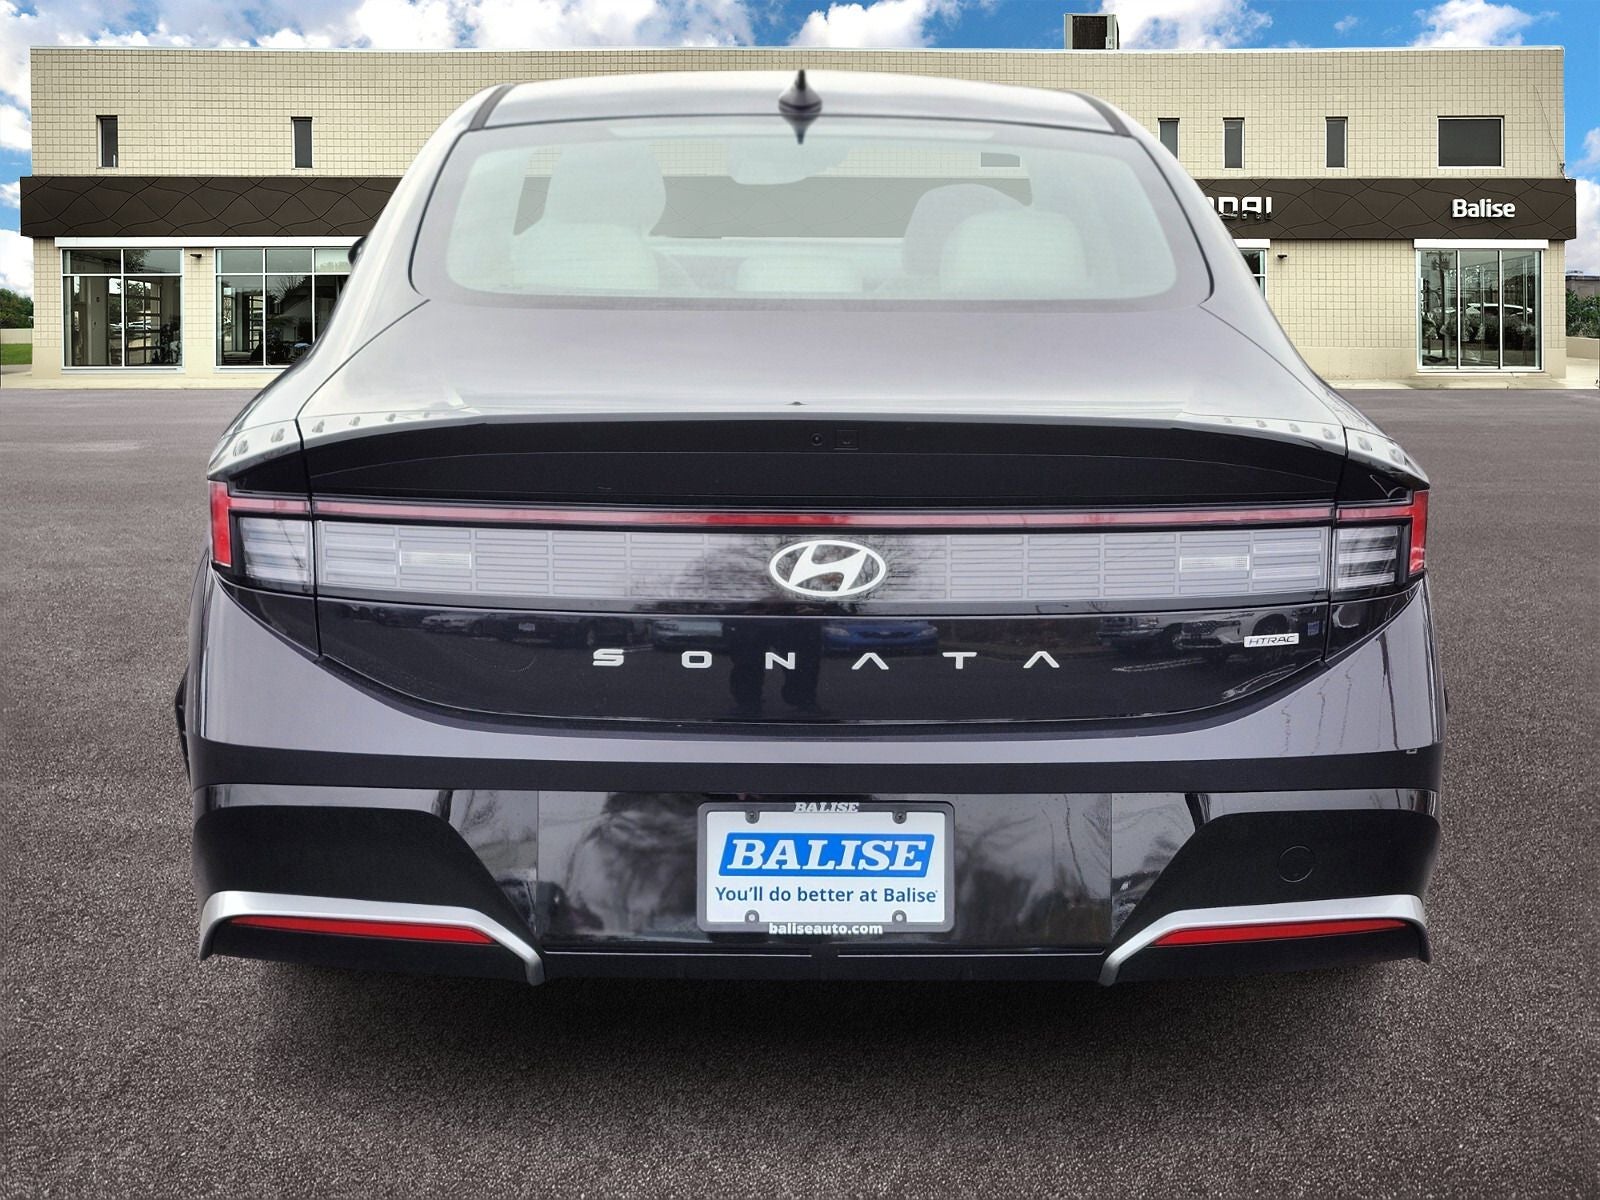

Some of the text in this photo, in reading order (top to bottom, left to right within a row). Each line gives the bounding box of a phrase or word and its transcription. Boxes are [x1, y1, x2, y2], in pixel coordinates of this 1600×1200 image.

[1451, 198, 1516, 219] Balise
[1248, 635, 1296, 646] HTRAC
[592, 648, 1061, 671] SONATA
[793, 802, 860, 813] BALISE
[726, 839, 927, 872] BALISE
[715, 886, 937, 903] You'll do better at Balise
[768, 922, 883, 935] baliseauto.com
